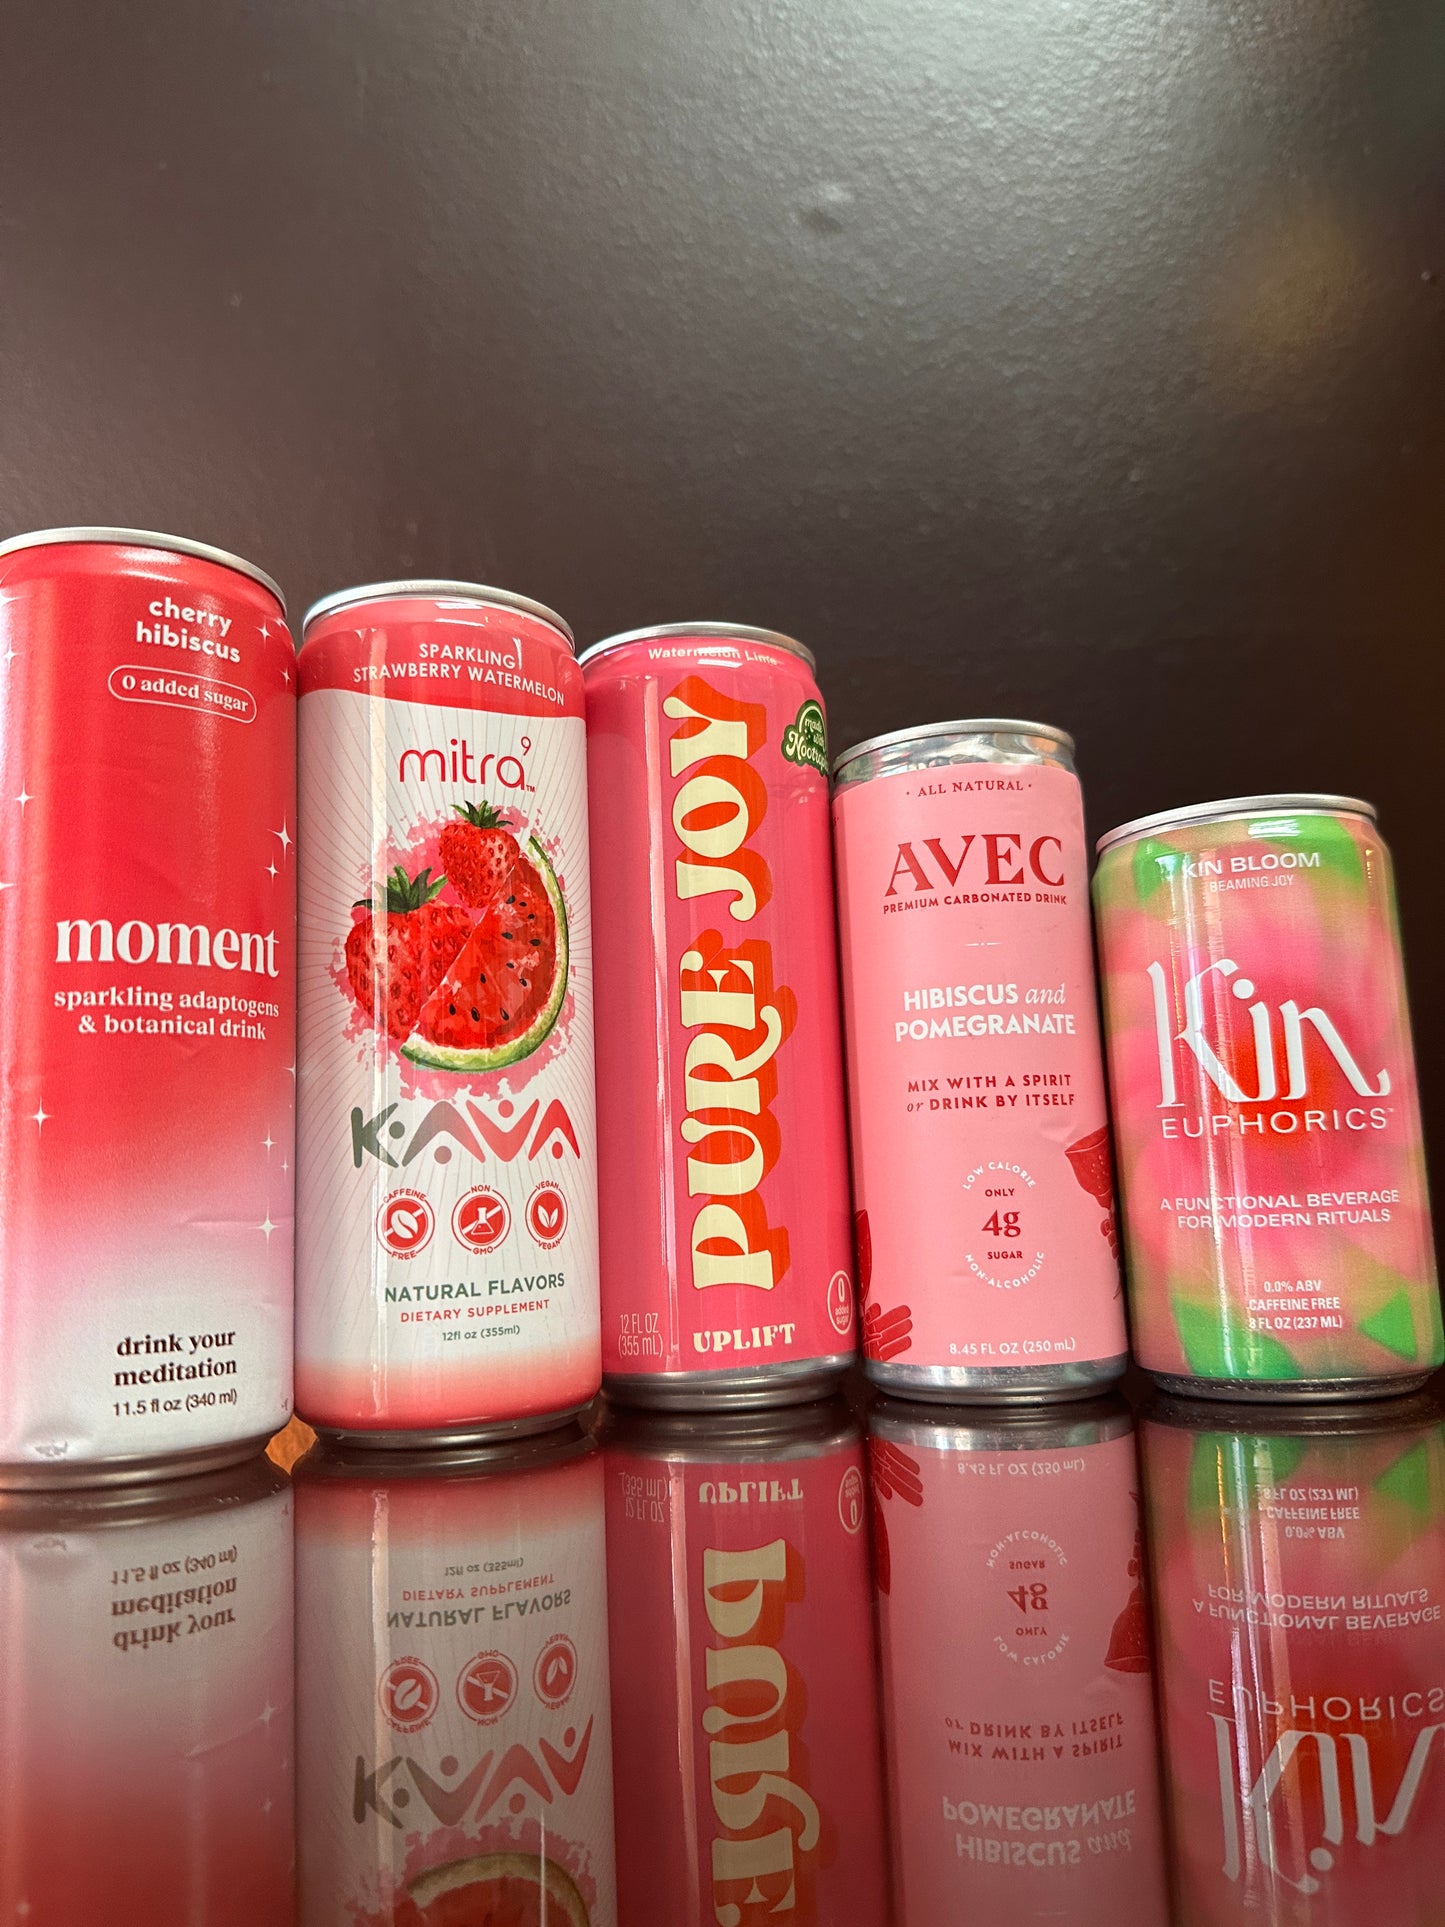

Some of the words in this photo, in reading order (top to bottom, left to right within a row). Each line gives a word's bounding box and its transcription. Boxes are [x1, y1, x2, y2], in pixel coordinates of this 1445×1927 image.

[149, 597, 232, 637] cherry
[136, 621, 241, 663] hibiscus
[419, 643, 516, 669] SPARKLING
[745, 650, 777, 666] Lime
[122, 675, 136, 690] 0
[141, 679, 200, 700] added
[204, 689, 248, 712] sugar
[353, 664, 462, 683] STRAWBERRY
[467, 667, 565, 707] WATERMELON
[918, 783, 947, 797] ALL
[952, 780, 1024, 793] NATURAL
[662, 686, 766, 922] JOY
[884, 833, 1065, 897] AVEC
[1183, 859, 1222, 879] KIN
[1230, 852, 1320, 873] BLOOM
[1209, 876, 1269, 893] BEAMING
[1271, 874, 1294, 888] JOY
[883, 897, 939, 915] PREMIUM
[943, 892, 1032, 906] CARBONATED
[1035, 892, 1067, 906] DRINK
[55, 918, 280, 977] moment
[53, 986, 174, 1011] sparkling
[179, 991, 279, 1018] adaptogens
[903, 983, 1018, 1012] HIBISCUS
[1025, 982, 1066, 1005] and
[78, 1015, 97, 1034] &
[104, 1014, 215, 1036] botanical
[219, 1018, 266, 1040] drink
[895, 1013, 1076, 1042] POMEGRANATE
[1146, 958, 1391, 1108] Kin
[907, 1078, 940, 1093] MIX
[946, 1075, 997, 1090] WITH
[1004, 1075, 1016, 1087] A
[1022, 1074, 1072, 1087] SPIRIT
[680, 938, 792, 1291] PURE
[907, 1101, 924, 1113] or
[929, 1095, 988, 1111] DRINK
[995, 1094, 1018, 1108] BY
[1025, 1093, 1075, 1107] ITSELF
[350, 1098, 581, 1169] KAVA
[1161, 1107, 1387, 1139] EUPHORICS
[535, 1180, 560, 1191] VEGAN
[962, 1165, 985, 1190] LOW
[988, 1161, 1036, 1188] CALORIE
[383, 1188, 427, 1204] CAFFEINE
[470, 1184, 491, 1194] NON
[984, 1188, 1015, 1197] ONLY
[1160, 1198, 1172, 1211] A
[1175, 1194, 1302, 1211] FUNCTIONAL
[1306, 1189, 1400, 1209] BEVERAGE
[981, 1209, 1021, 1238] 4g
[1177, 1215, 1214, 1230] FOR
[1219, 1212, 1312, 1229] MODERN
[1316, 1208, 1391, 1226] RITUALS
[391, 1250, 418, 1261] FREE
[472, 1246, 494, 1256] GMO
[537, 1239, 561, 1251] VEGAN
[987, 1250, 1023, 1260] SUGAR
[965, 1251, 1045, 1289] NON-ALCOHOLIC
[384, 1281, 482, 1303] NATURAL
[488, 1272, 565, 1296] FLAVORS
[1263, 1280, 1294, 1293] 0.0%
[1296, 1280, 1322, 1292] ABV
[400, 1308, 462, 1323] DIETARY
[467, 1299, 550, 1318] SUPPLEMENT
[1249, 1297, 1309, 1312] CAFFEINE
[1311, 1296, 1341, 1311] FREE
[464, 1331, 477, 1340] oz
[480, 1324, 521, 1339] (355ml)
[619, 1314, 631, 1335] 12
[632, 1314, 643, 1334] FL
[644, 1312, 659, 1333] OZ
[1249, 1318, 1257, 1330] 8
[1258, 1317, 1272, 1329] FL
[1275, 1317, 1291, 1329] OZ
[1293, 1316, 1318, 1330] (237
[1320, 1315, 1343, 1329] ML)
[116, 1333, 183, 1356] drink
[188, 1331, 236, 1355] your
[618, 1334, 641, 1358] (355
[693, 1323, 796, 1354] UPLIFT
[949, 1342, 977, 1355] 8.45
[981, 1343, 996, 1355] FL
[999, 1342, 1019, 1354] OZ
[1022, 1340, 1051, 1355] (250
[1053, 1337, 1076, 1352] mL)
[113, 1357, 237, 1386] meditation
[113, 1400, 146, 1416] 11.5
[150, 1398, 160, 1413] fl
[163, 1399, 182, 1412] oz
[185, 1392, 216, 1412] (340
[218, 1388, 237, 1406] ml)
